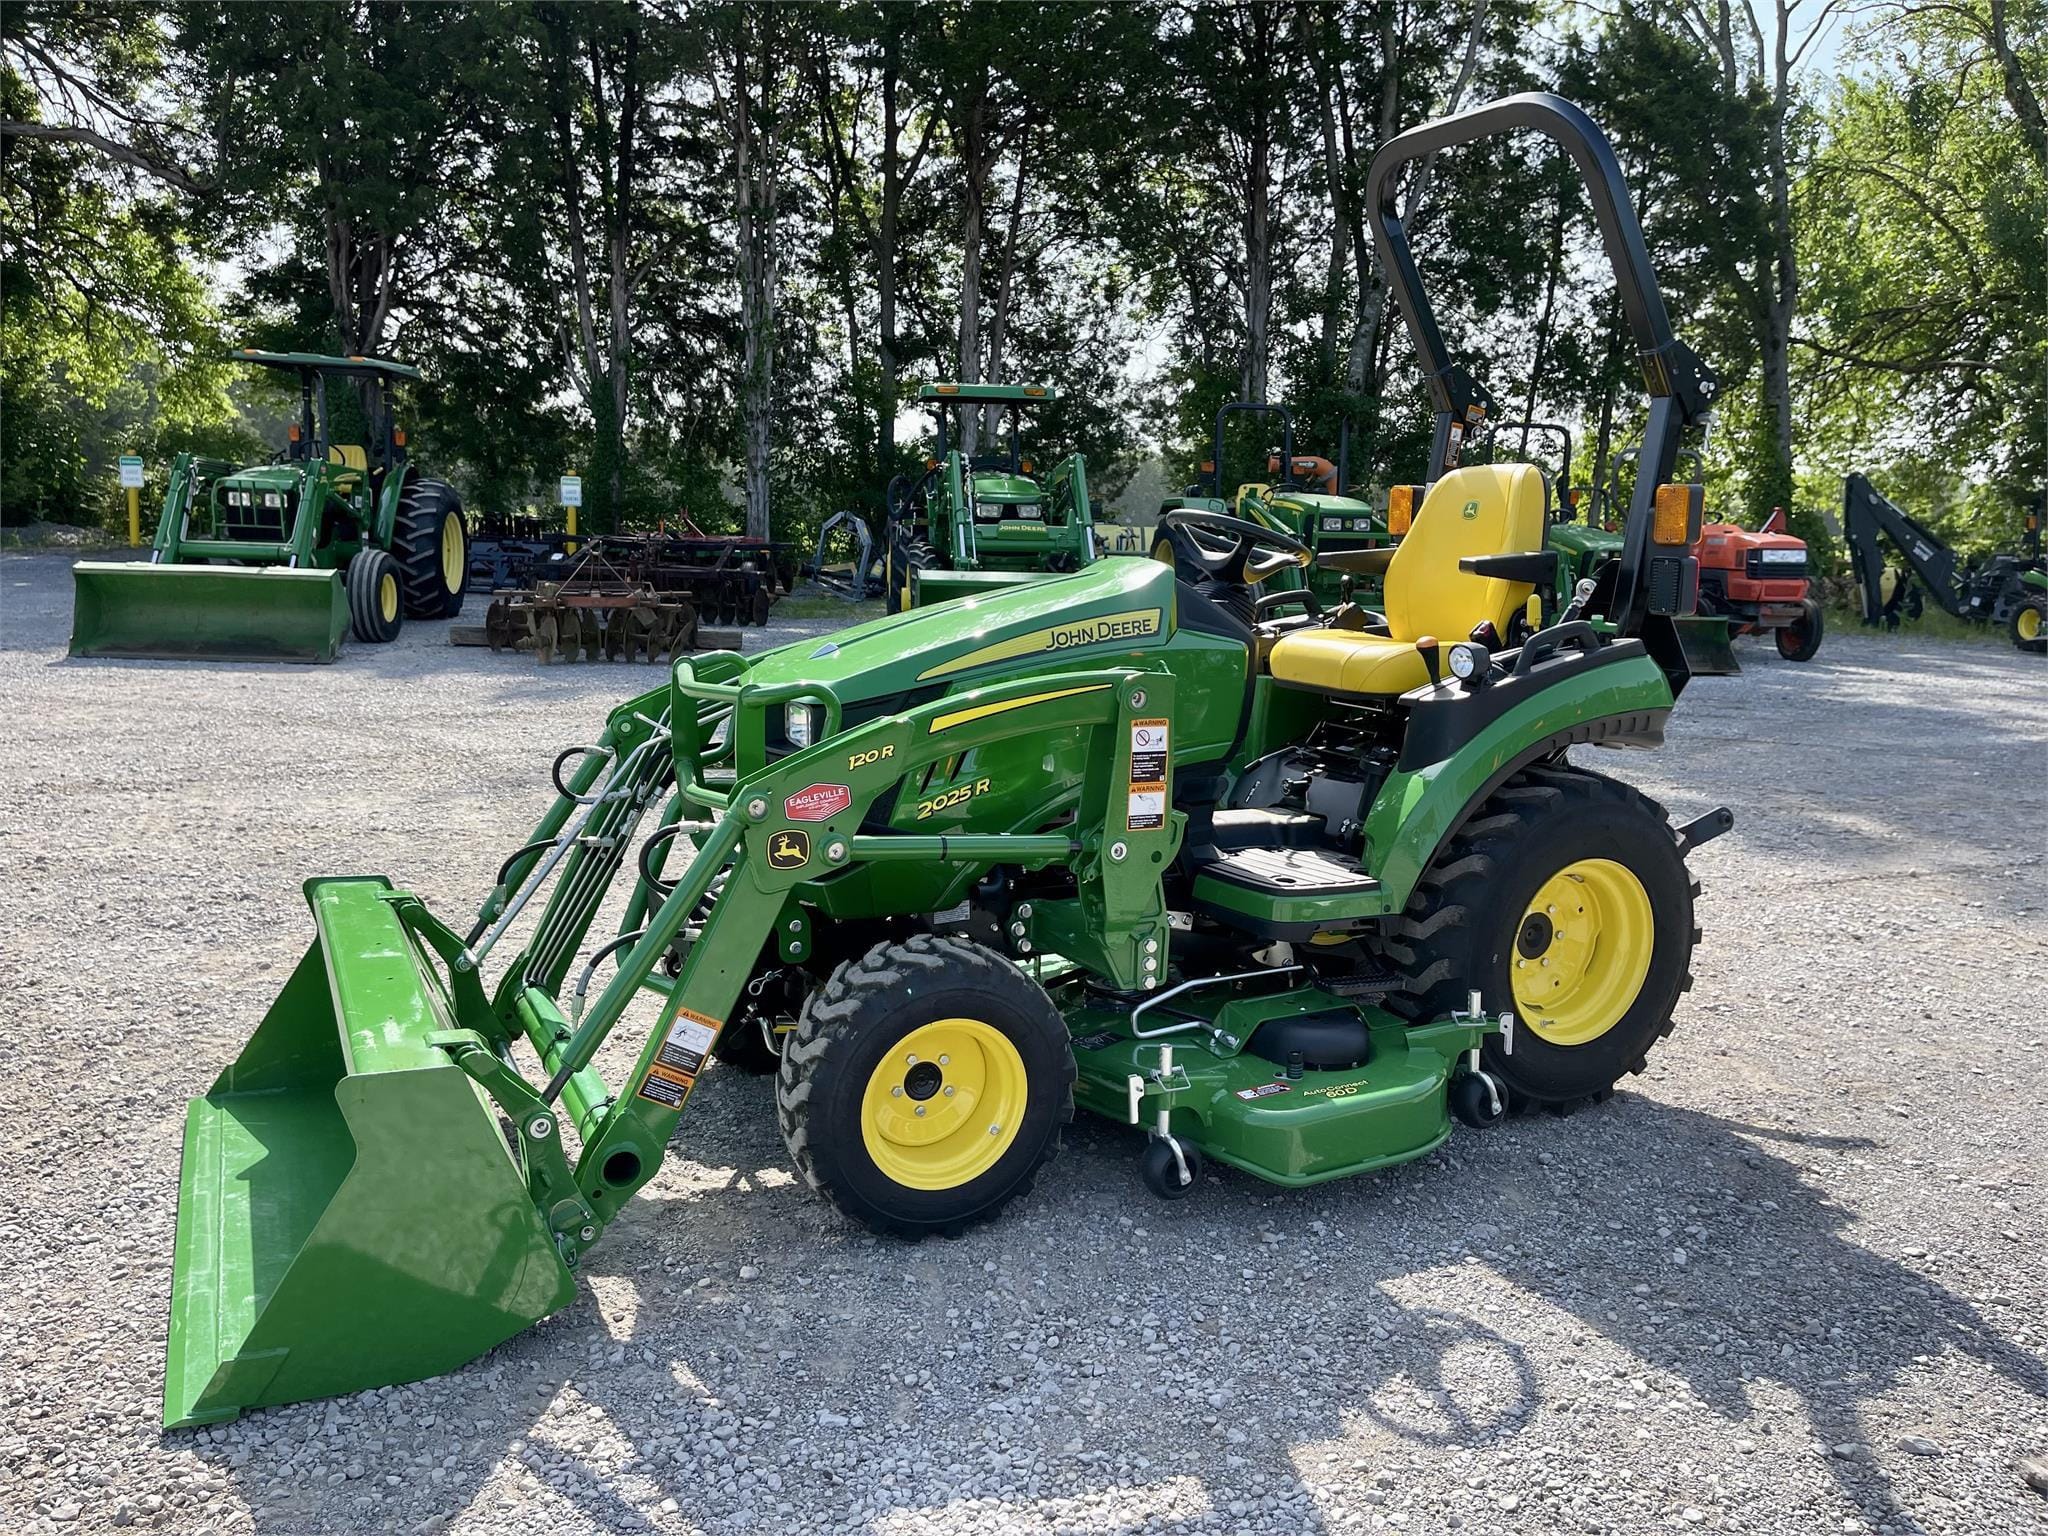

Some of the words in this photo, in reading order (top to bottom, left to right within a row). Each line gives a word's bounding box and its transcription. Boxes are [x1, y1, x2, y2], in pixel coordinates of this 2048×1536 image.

[1046, 627, 1094, 649] JOHN
[1097, 619, 1152, 639] DEERE
[848, 749, 879, 771] 120
[881, 744, 895, 760] R
[789, 787, 846, 807] EAGLEVILLE
[1137, 785, 1165, 793] WARNING
[917, 783, 973, 821] 2025
[975, 778, 991, 797] R
[689, 1013, 717, 1028] WARNING
[661, 1069, 689, 1085] WARNING
[1303, 1080, 1369, 1097] AutoConnect
[1325, 1087, 1358, 1098] 60D
